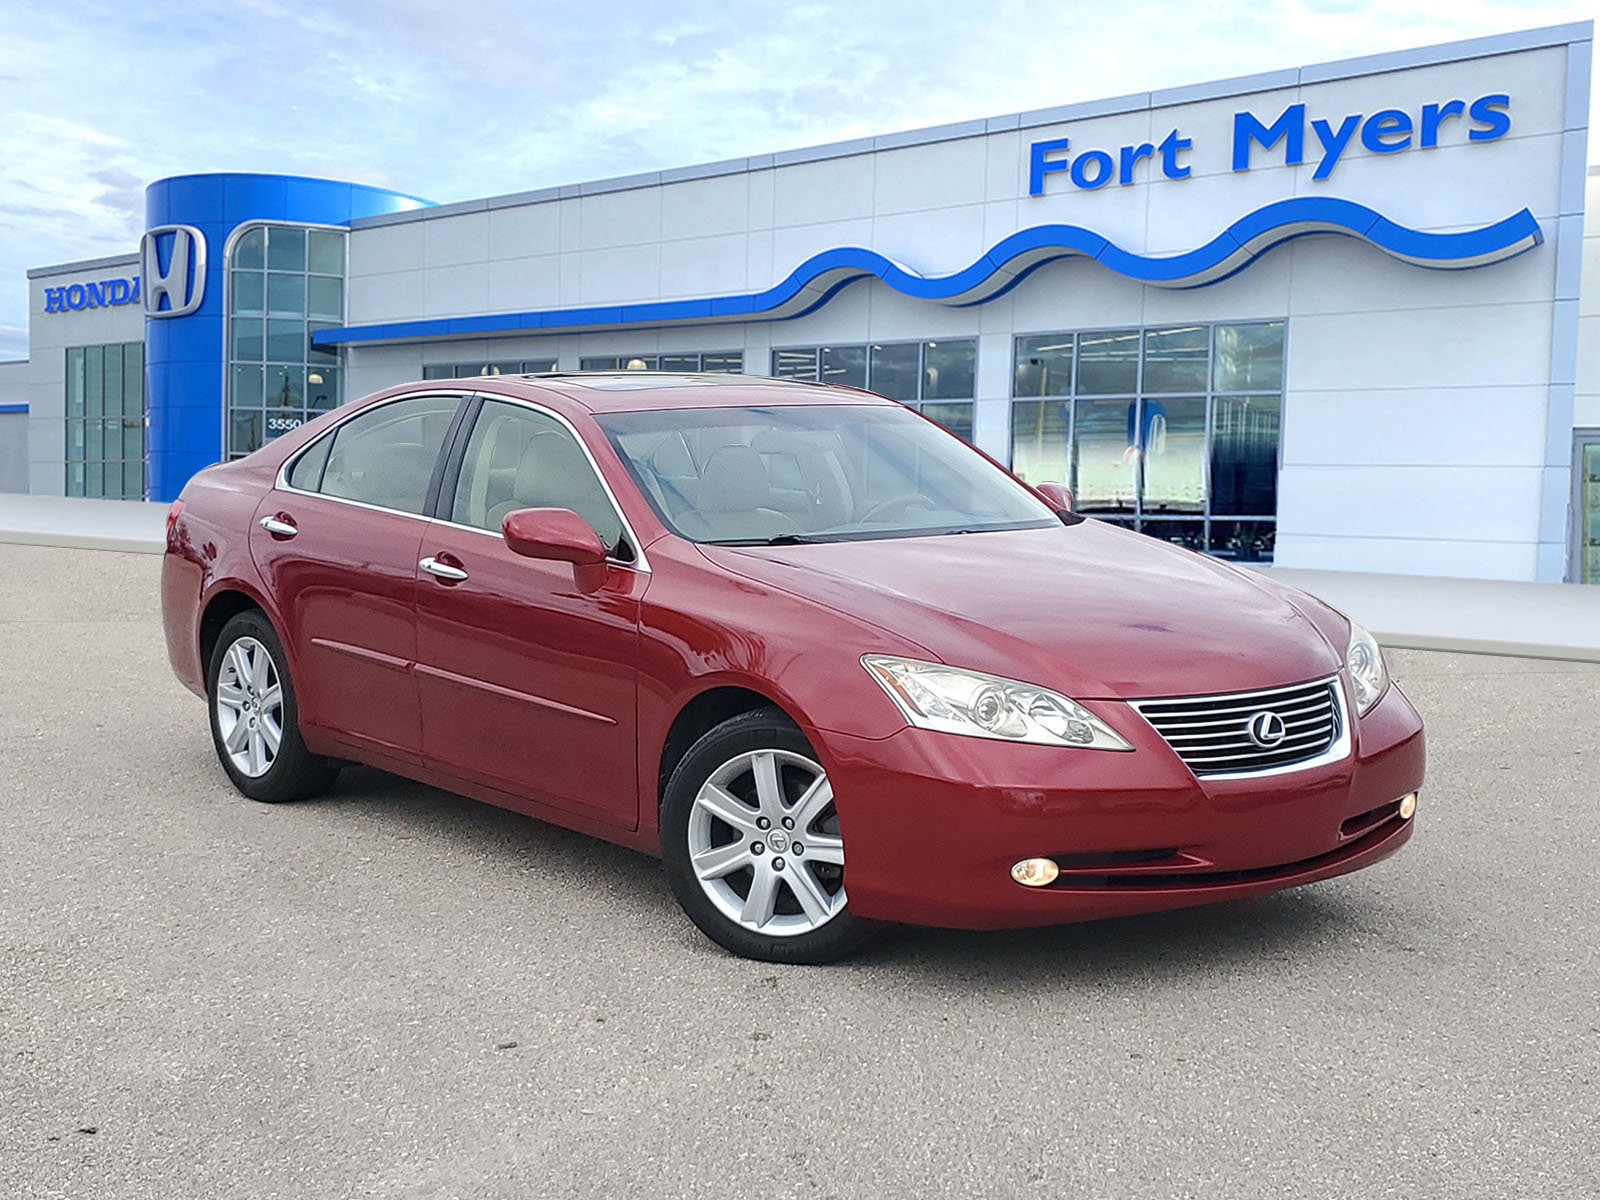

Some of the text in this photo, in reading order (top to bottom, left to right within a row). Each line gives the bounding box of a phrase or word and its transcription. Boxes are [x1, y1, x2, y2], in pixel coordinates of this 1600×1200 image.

[1030, 93, 1511, 196] Fort Myers
[268, 418, 302, 430] 3550
